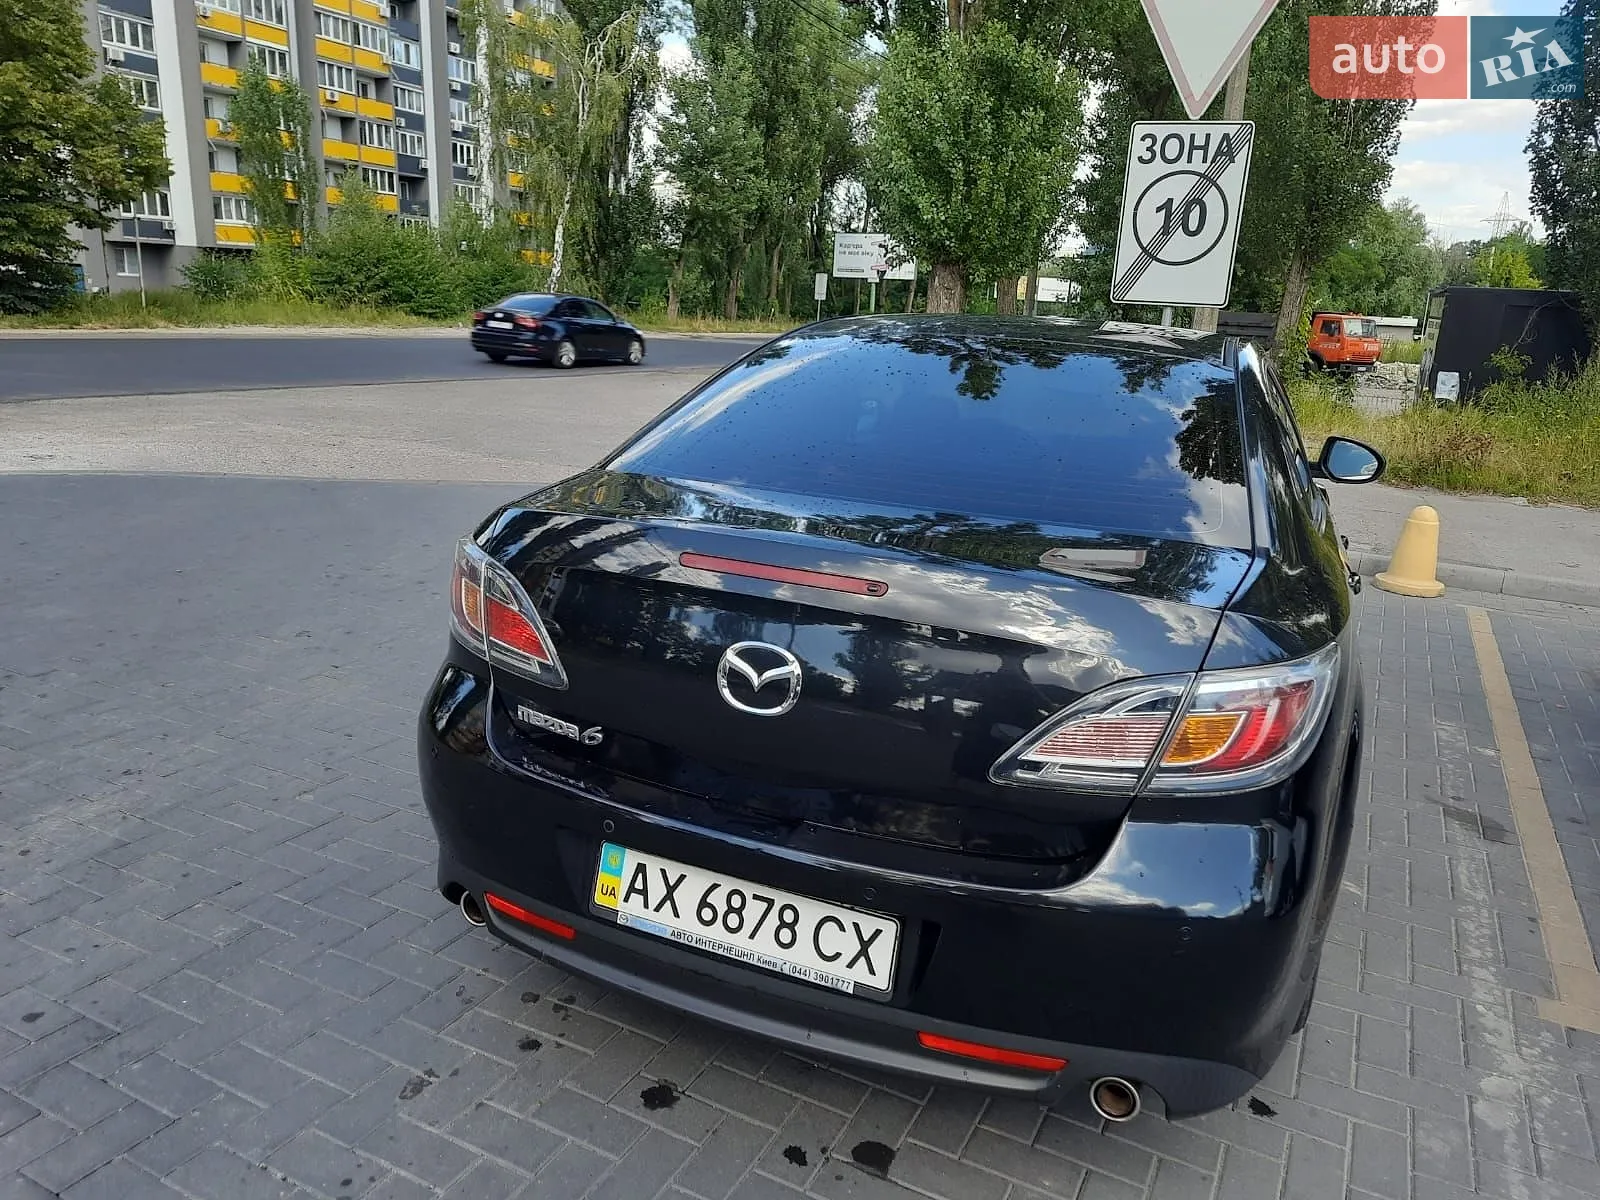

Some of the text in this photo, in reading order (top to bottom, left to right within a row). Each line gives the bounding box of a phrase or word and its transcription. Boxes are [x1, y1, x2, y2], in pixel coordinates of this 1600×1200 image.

[1137, 132, 1236, 165] ЗОНА
[1155, 197, 1208, 237] 10
[600, 883, 617, 900] UA
[622, 862, 884, 977] AX 6878 CX
[671, 929, 851, 990] АВТО ИНТЕРНЕШНЛ Киев (044) 3901777
